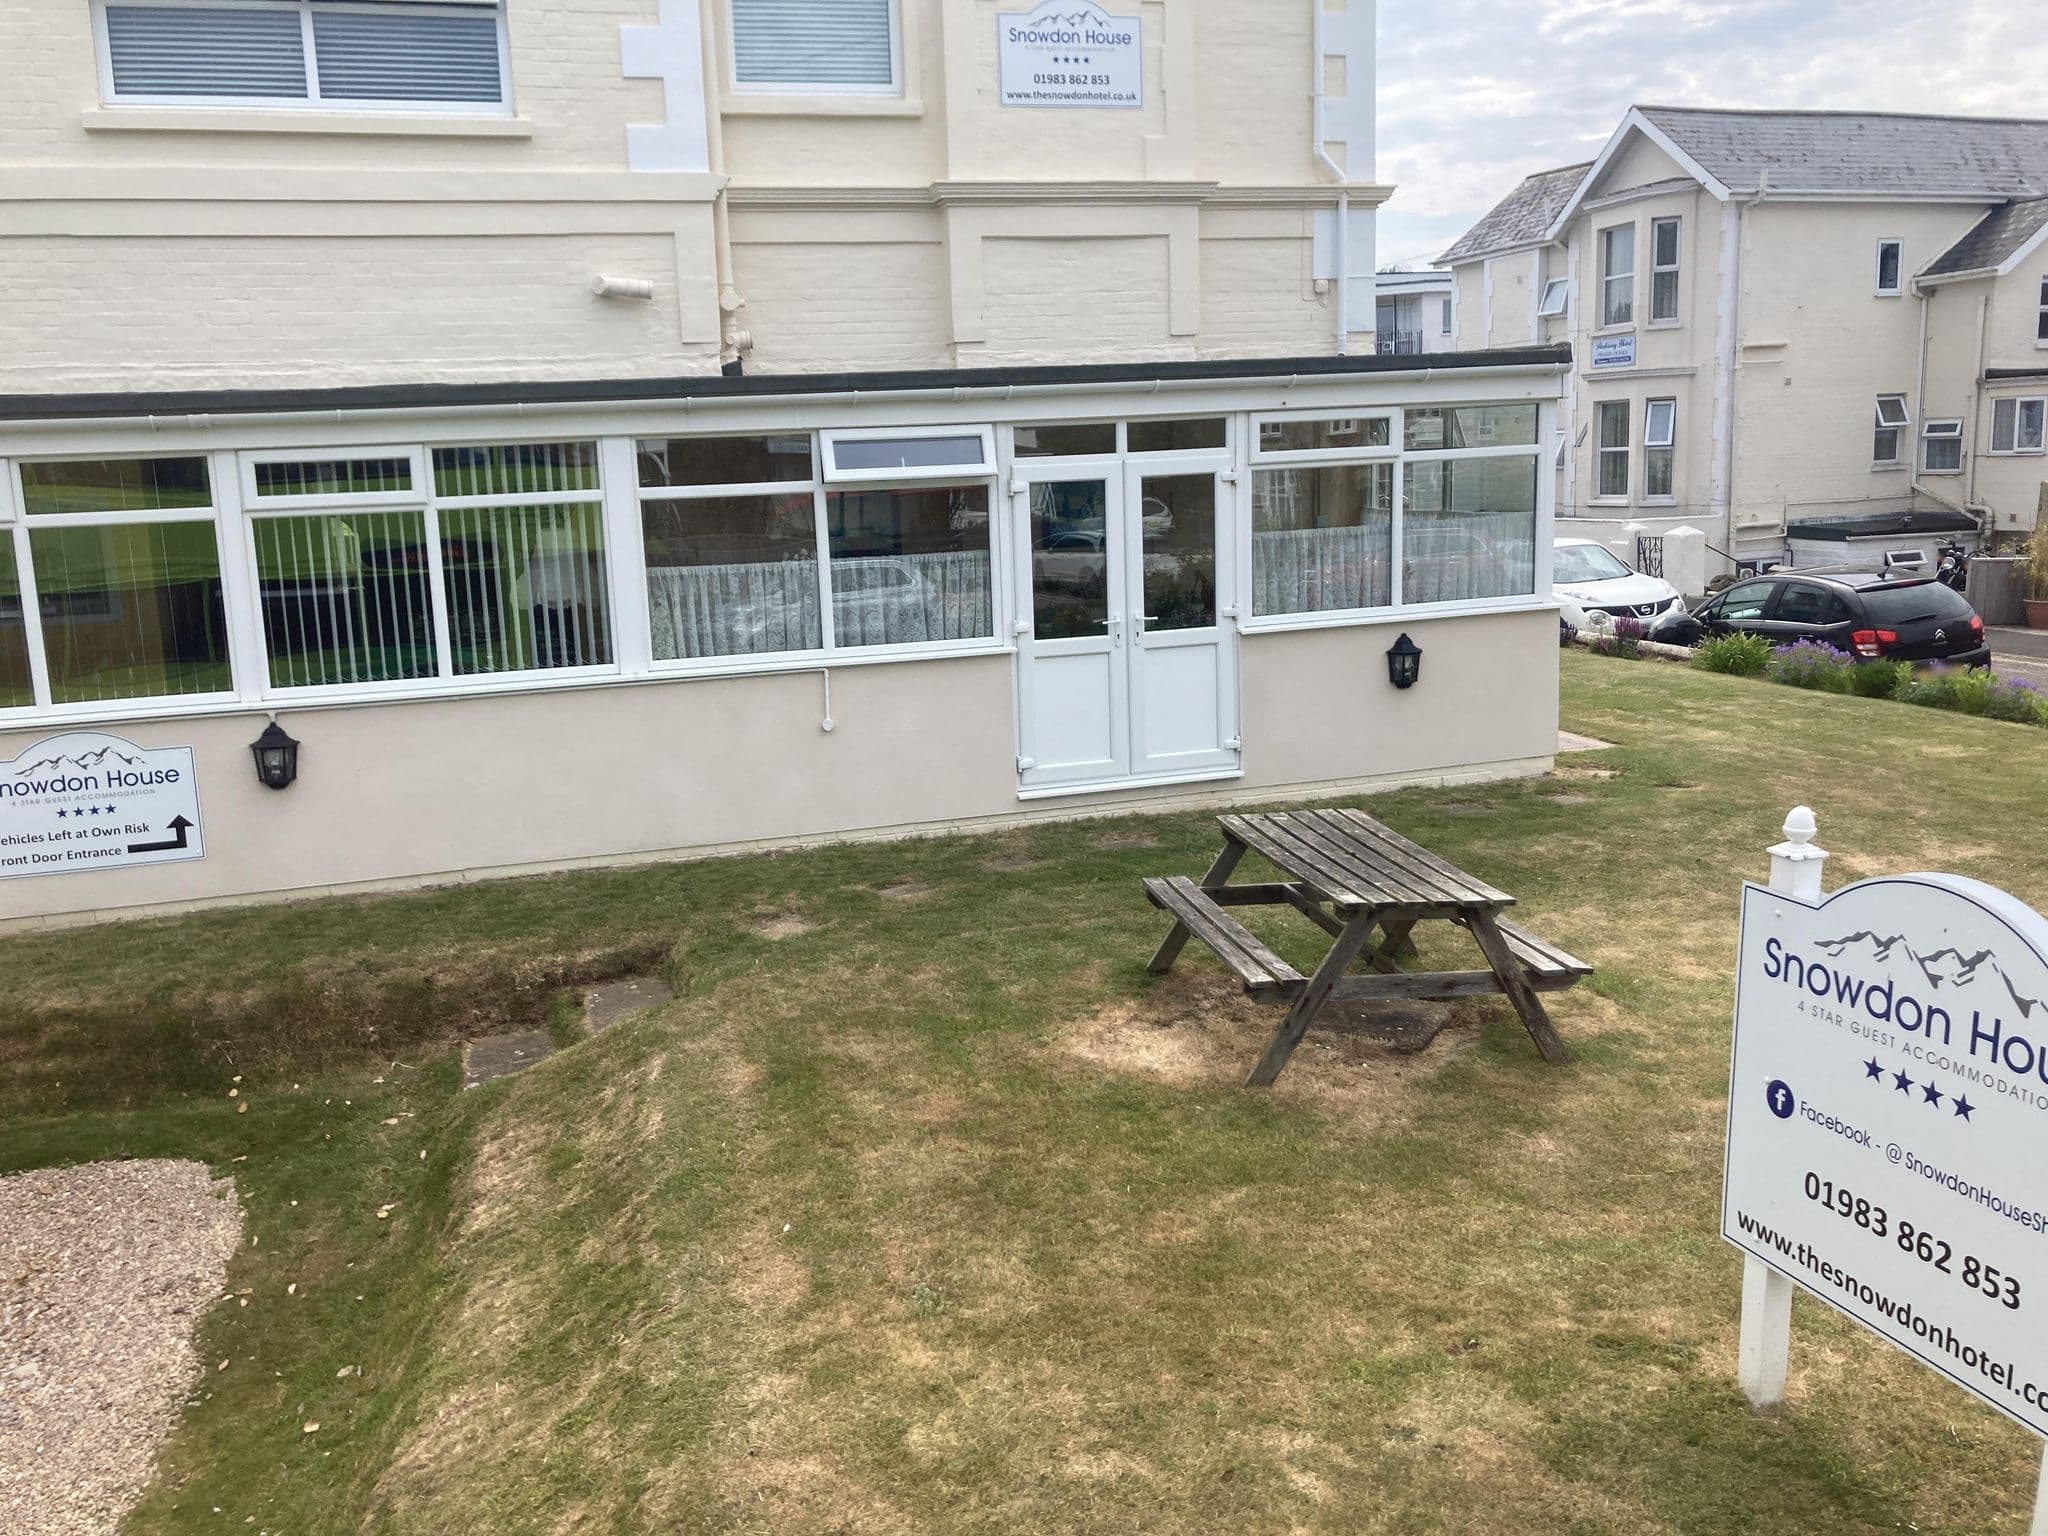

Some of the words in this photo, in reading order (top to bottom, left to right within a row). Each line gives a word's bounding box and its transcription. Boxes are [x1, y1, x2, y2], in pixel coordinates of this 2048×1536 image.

[1009, 27, 1080, 44] Snowdon
[1085, 30, 1131, 45] House
[1034, 74, 1066, 84] 01983
[1069, 75, 1088, 85] 862
[1091, 75, 1109, 85] 853
[1006, 89, 1136, 101] www.thesnowdonhotel.co.uk
[0, 774, 98, 797] nowdon
[107, 768, 180, 788] House
[20, 798, 41, 806] STAR
[44, 796, 71, 804] GUEST
[75, 789, 156, 801] ACCOMMODATION
[0, 832, 45, 846] ehicles
[49, 829, 72, 842] Left
[75, 829, 88, 839] at
[92, 827, 121, 837] Own
[125, 822, 151, 834] Risk
[1, 856, 28, 866] ront
[32, 852, 63, 863] Door
[67, 847, 122, 860] Entrance
[1764, 937, 1950, 1045] Snowdon
[1798, 1001, 1805, 1012] 4
[1812, 1005, 1843, 1028] STAR
[1851, 1021, 1896, 1049] GUEST
[1902, 1042, 2048, 1110] ACCOMMODATIO
[1800, 1101, 1871, 1148] Facebook
[1804, 1171, 1888, 1238] 01983
[1897, 1221, 1951, 1274] 862
[1962, 1256, 2021, 1310] 853
[1738, 1210, 2048, 1413] www.thesnowdonhotel.co
